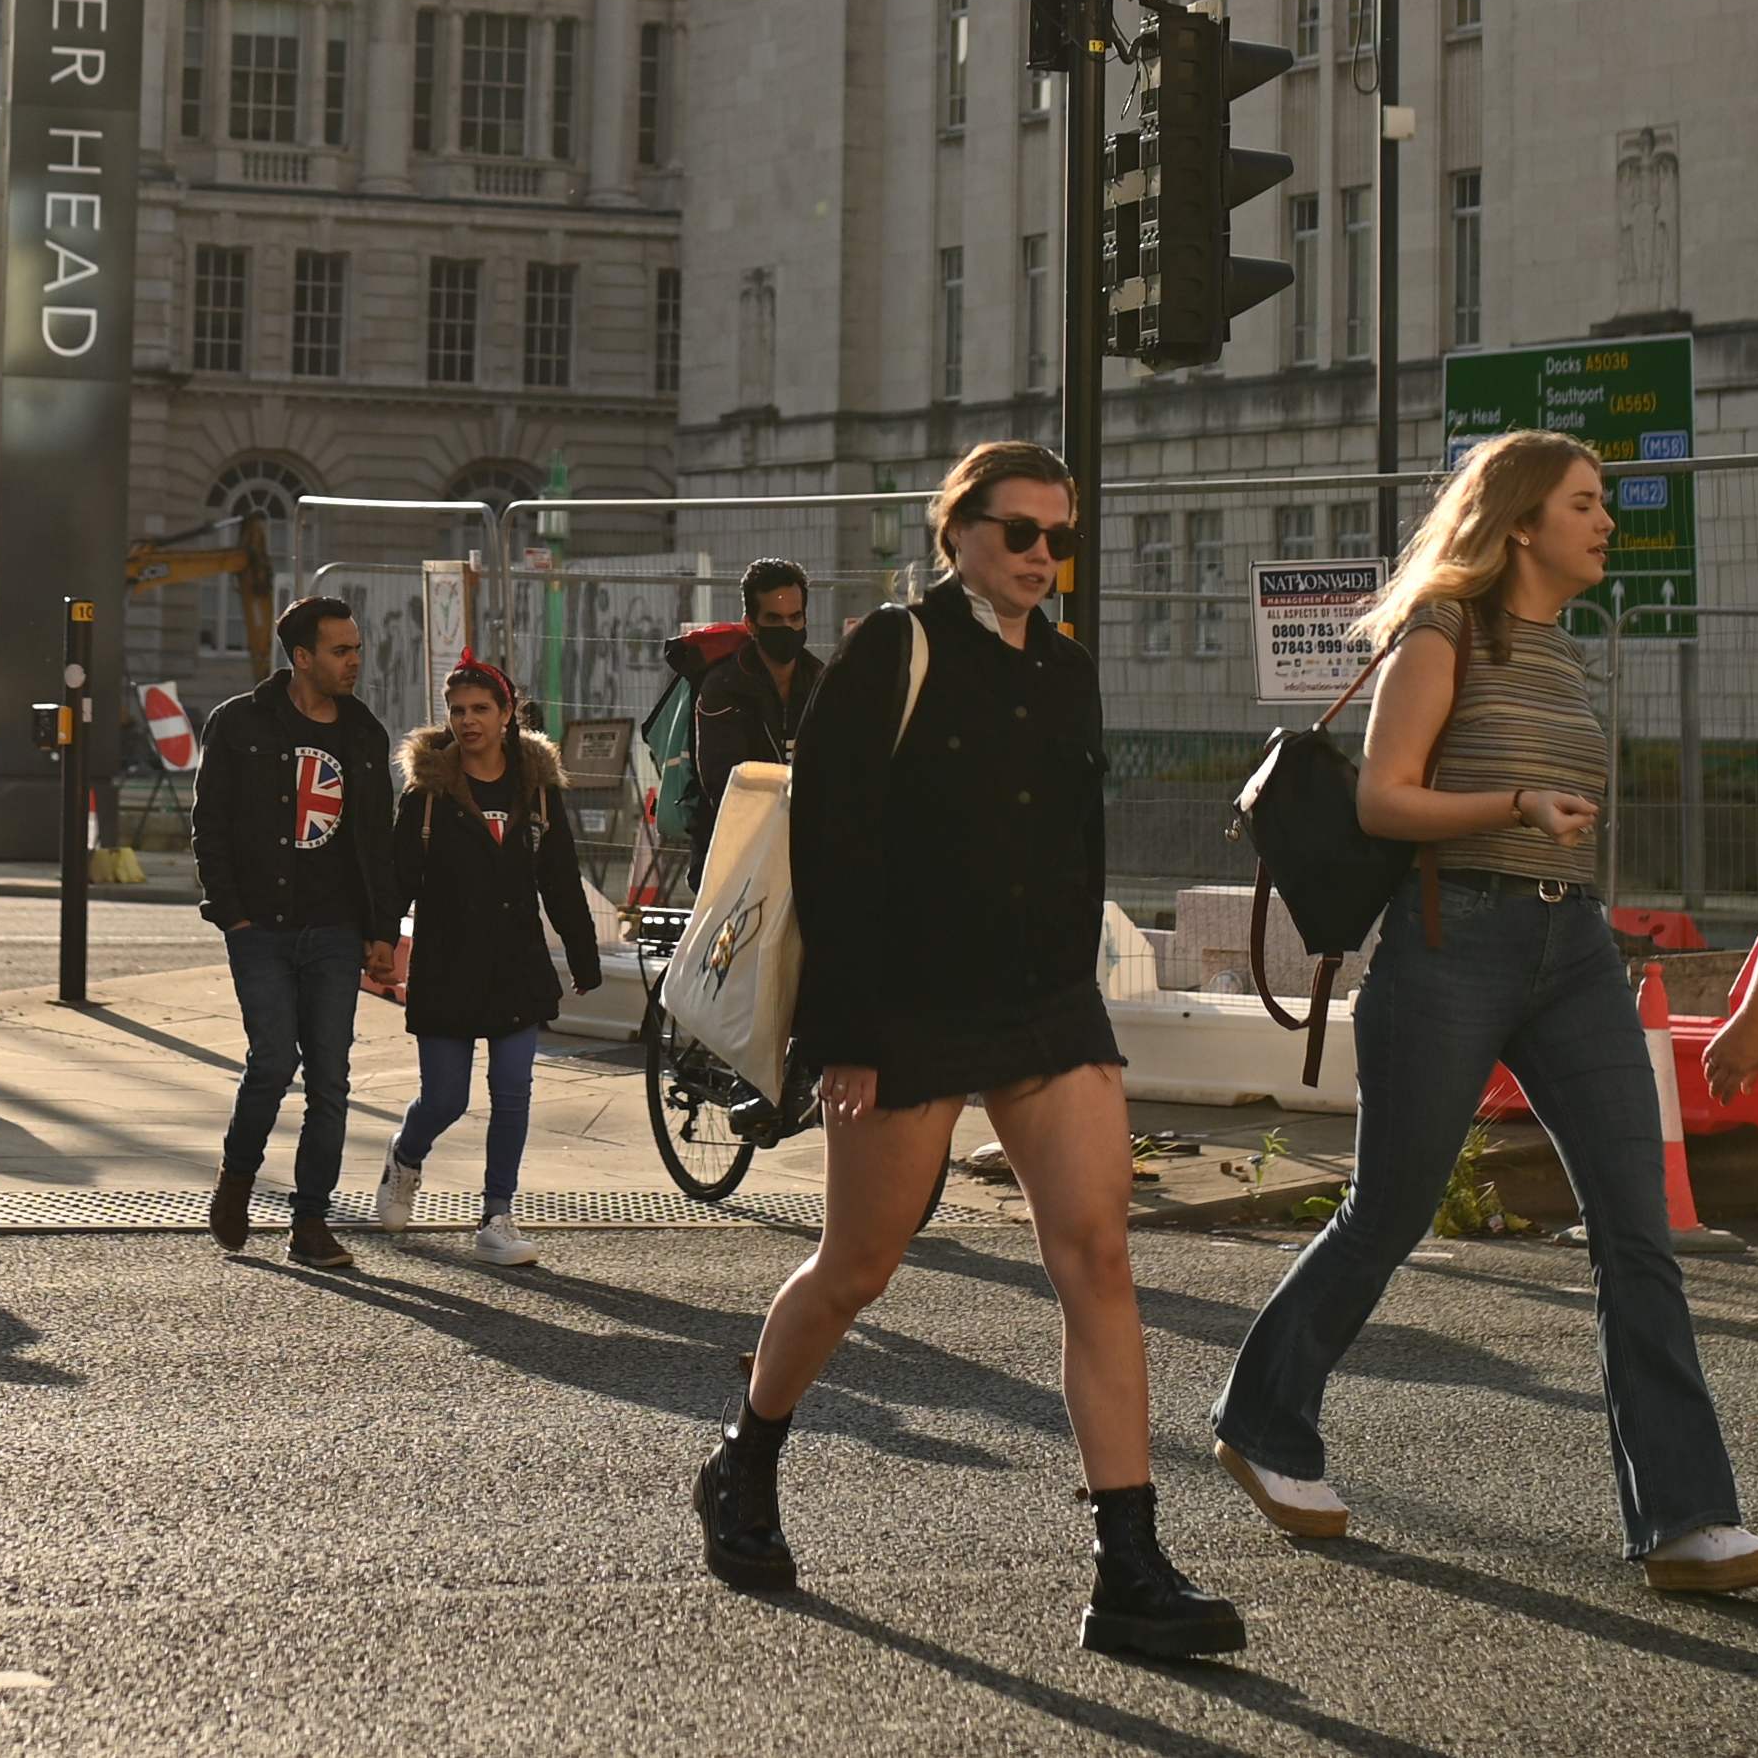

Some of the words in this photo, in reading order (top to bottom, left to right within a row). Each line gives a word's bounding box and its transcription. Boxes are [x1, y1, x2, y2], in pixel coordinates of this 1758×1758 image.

[41, 128, 103, 359] HEAD
[1545, 356, 1582, 375] Docks
[1586, 352, 1629, 371] A5036
[1546, 385, 1605, 406] Southport
[1610, 392, 1657, 415] (A565)
[1447, 409, 1468, 427] Pier
[1473, 407, 1501, 425] Head
[1546, 410, 1586, 429] Bootle
[1644, 435, 1685, 459] (M58)
[1623, 480, 1664, 503] (M62)
[1263, 571, 1374, 592] NATIONWIDE
[1267, 609, 1280, 620] ALL
[1283, 607, 1318, 620] ASPECTS
[1272, 623, 1305, 639] 0800
[1309, 622, 1334, 637] 783
[1271, 640, 1313, 655] 07843
[1317, 639, 1342, 654] 999
